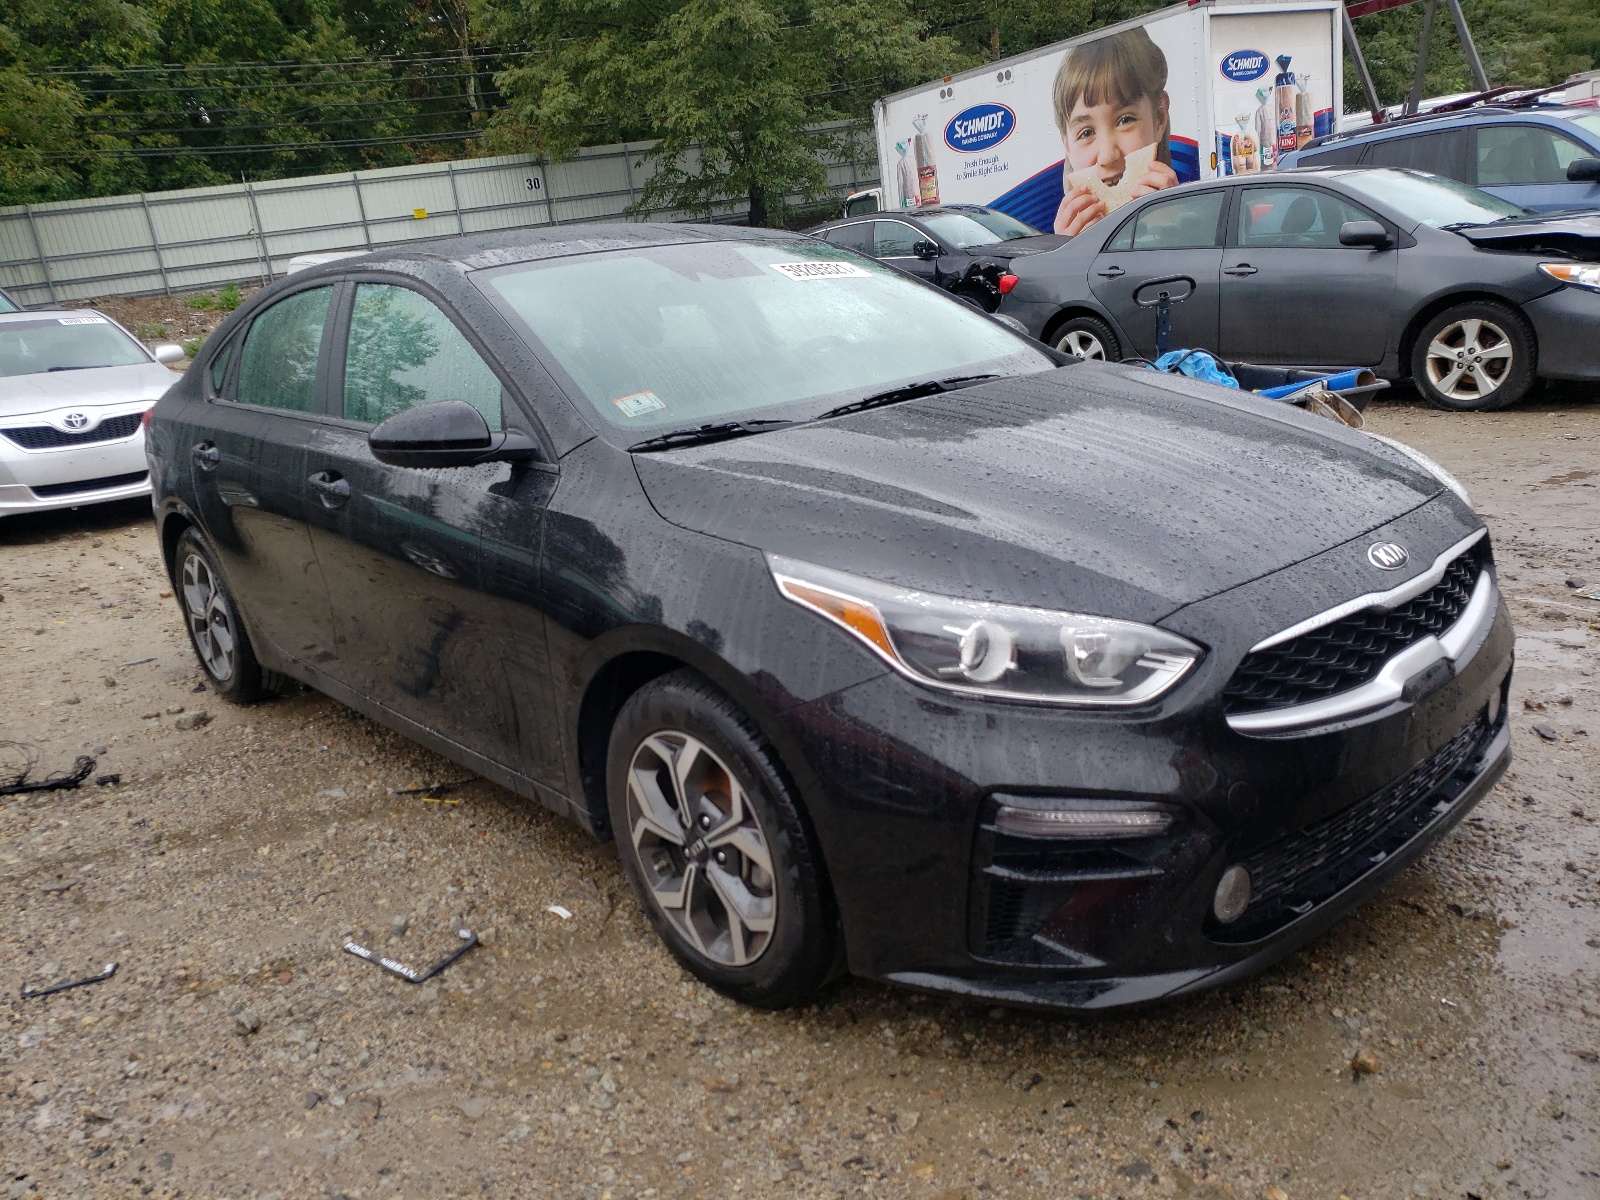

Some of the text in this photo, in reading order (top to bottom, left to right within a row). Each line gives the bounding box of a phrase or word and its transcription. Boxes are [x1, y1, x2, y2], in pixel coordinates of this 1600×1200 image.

[1227, 56, 1263, 71] SCHMIDT
[954, 111, 1004, 139] SCHMIDT
[1281, 137, 1294, 147] KING
[979, 155, 999, 166] Enough
[963, 170, 977, 180] Smile
[979, 166, 993, 178] Right
[526, 177, 540, 190] 30
[1372, 543, 1407, 566] KIA
